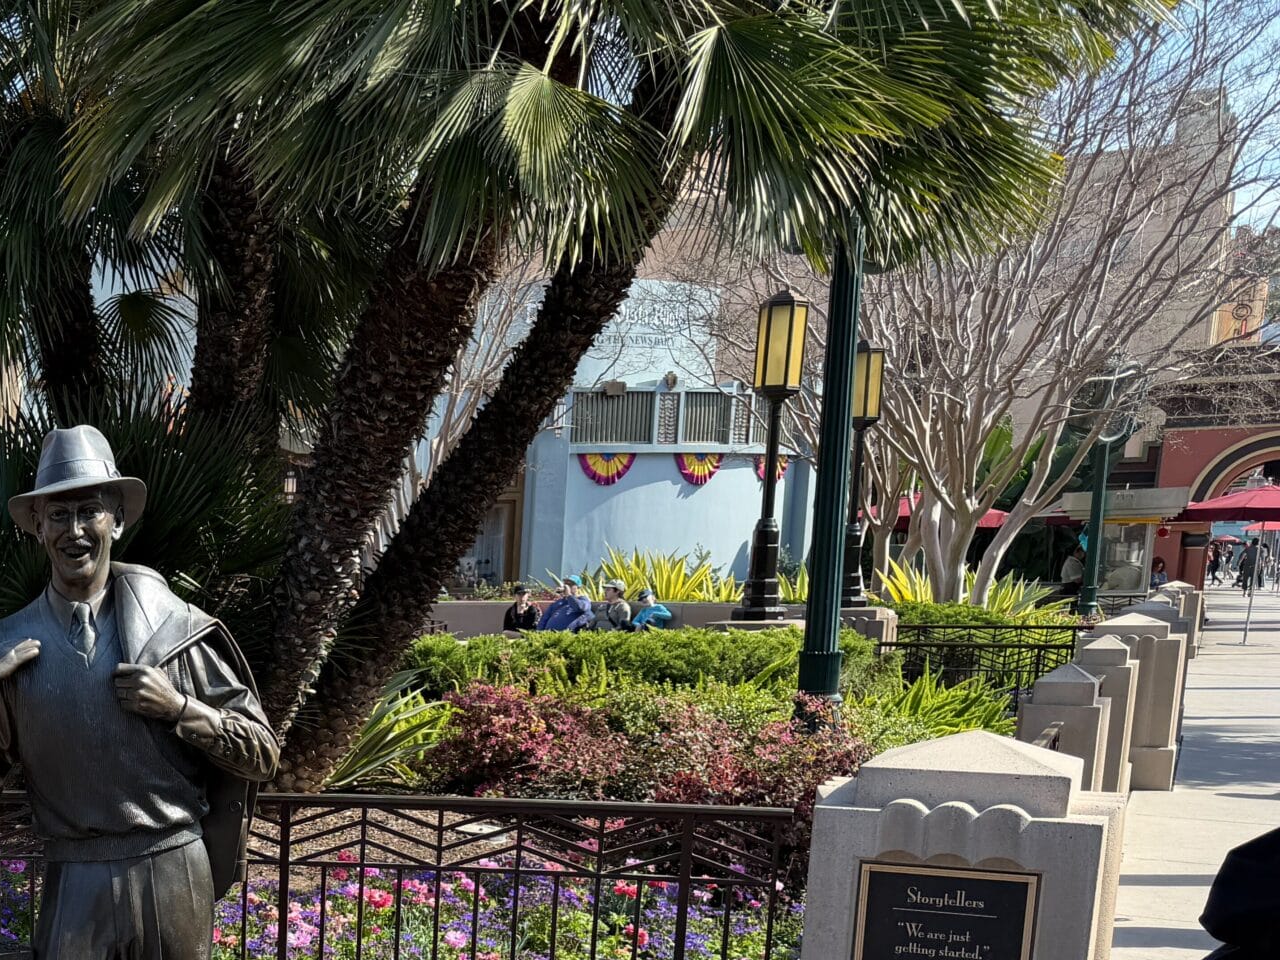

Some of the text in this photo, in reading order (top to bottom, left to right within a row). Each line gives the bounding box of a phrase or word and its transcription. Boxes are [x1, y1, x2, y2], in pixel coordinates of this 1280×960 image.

[629, 336, 652, 345] NEWS
[907, 886, 985, 909] Storytellers
[927, 931, 946, 940] are
[948, 930, 971, 942] just
[895, 942, 935, 957] getting
